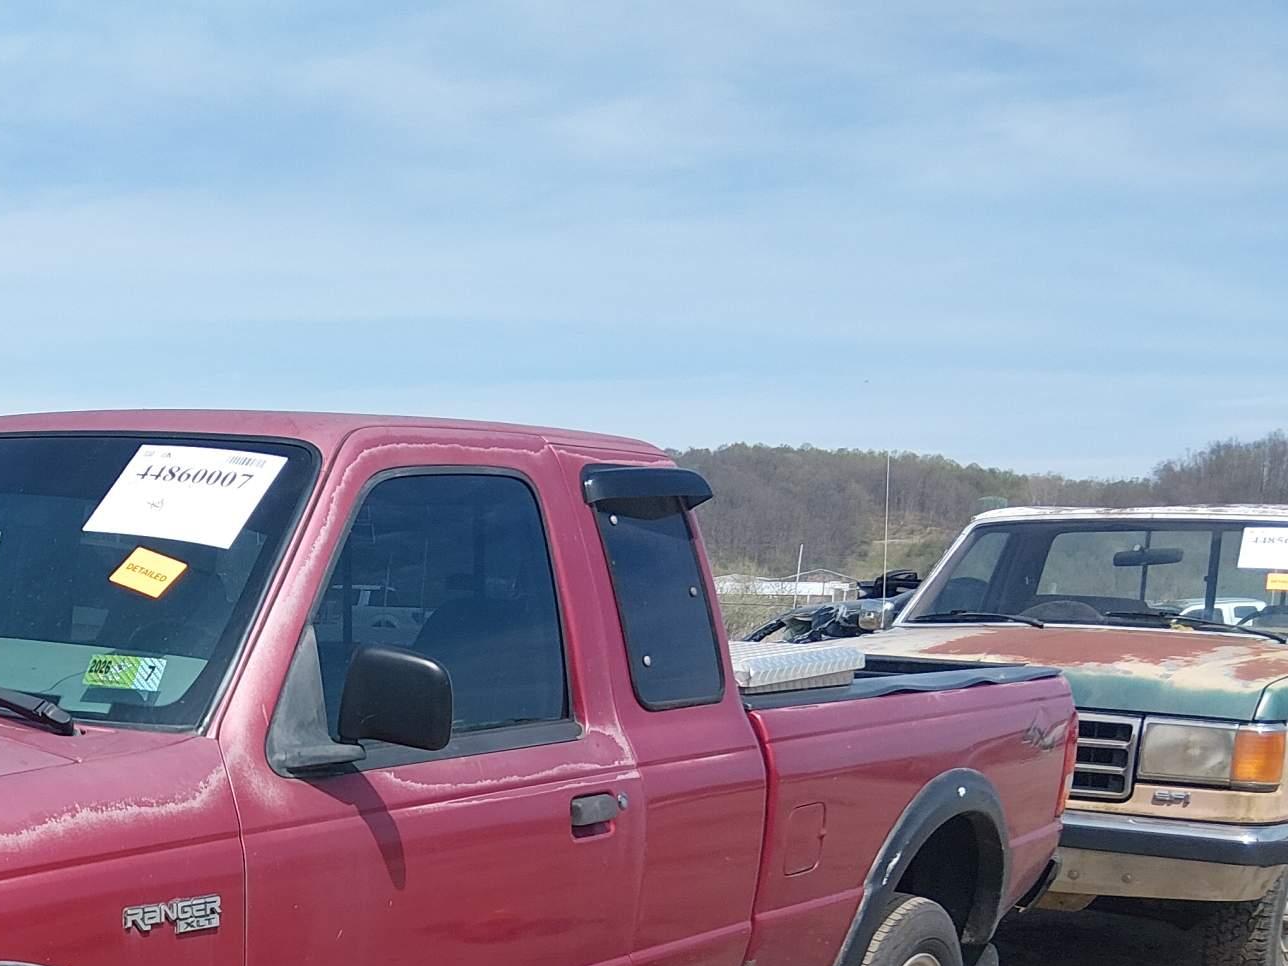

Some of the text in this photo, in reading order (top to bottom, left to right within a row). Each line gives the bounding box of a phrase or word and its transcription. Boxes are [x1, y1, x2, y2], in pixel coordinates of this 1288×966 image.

[136, 465, 254, 488] 44860007
[125, 561, 167, 583] DETAILED
[88, 659, 112, 675] 2026
[145, 665, 156, 681] 7
[123, 894, 221, 931] RANGER
[182, 916, 218, 931] XLT
